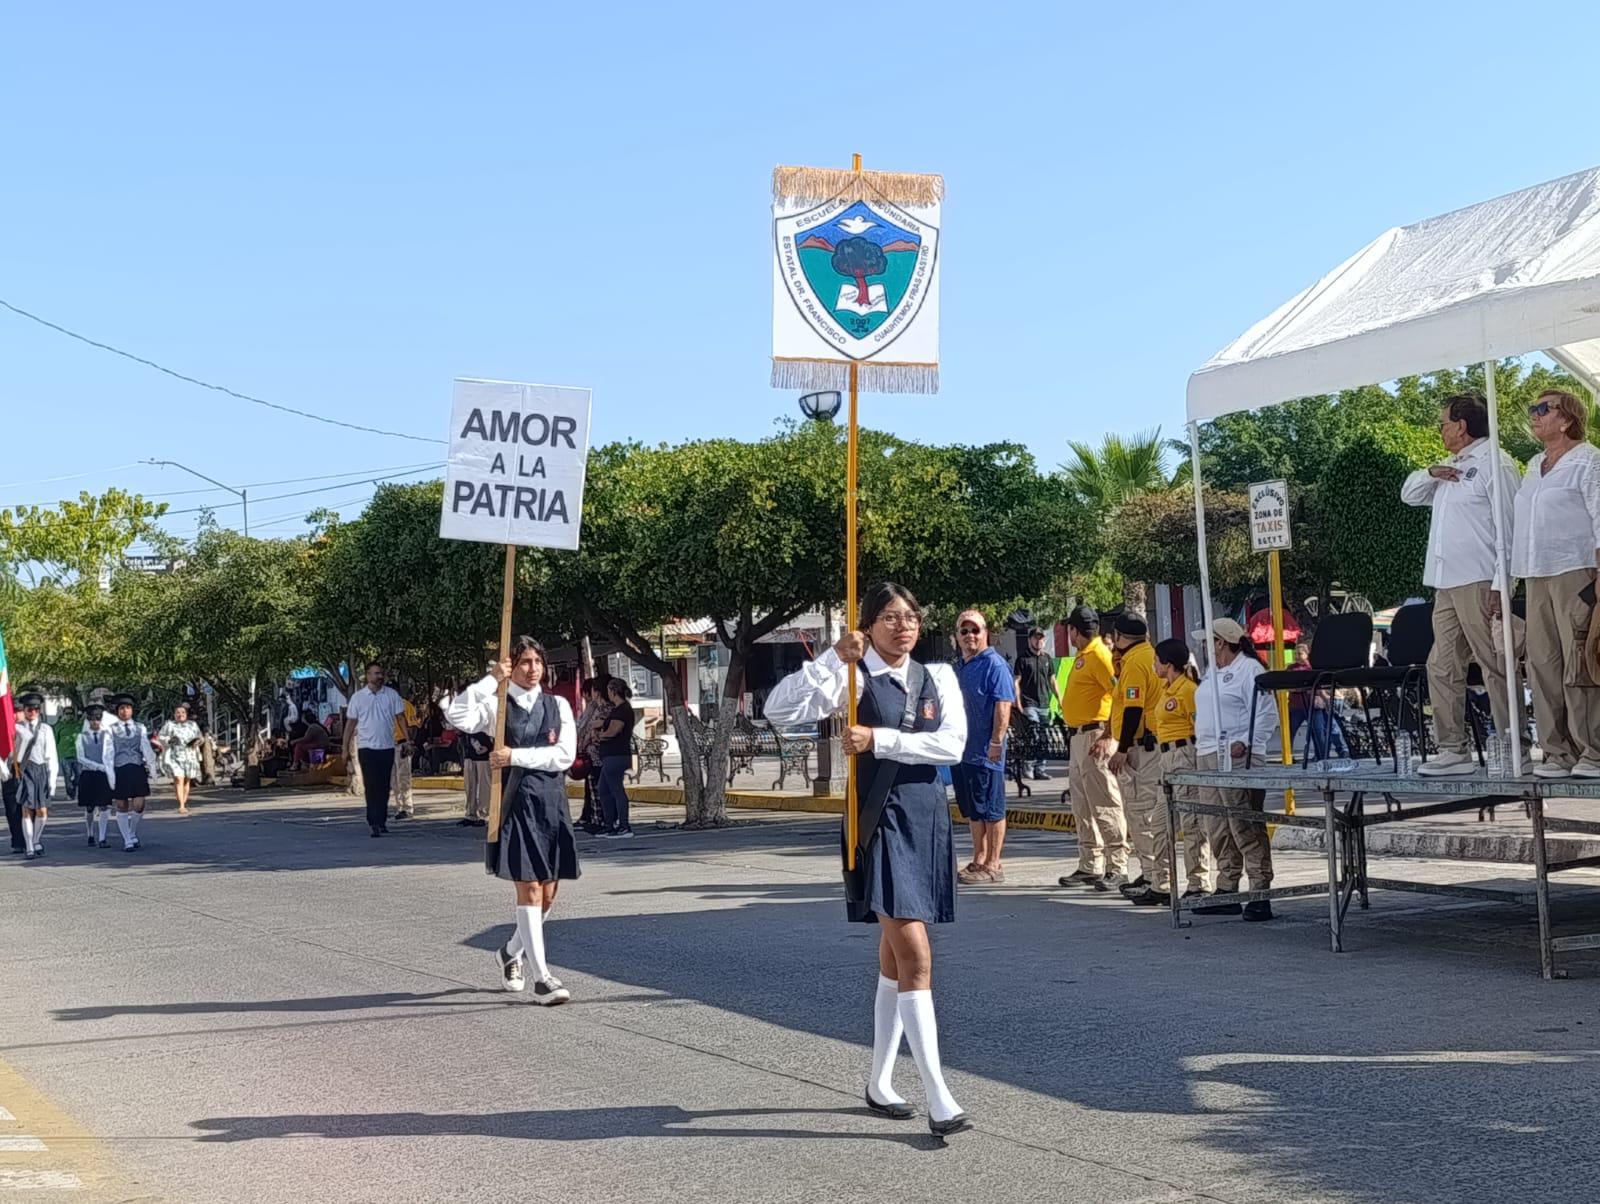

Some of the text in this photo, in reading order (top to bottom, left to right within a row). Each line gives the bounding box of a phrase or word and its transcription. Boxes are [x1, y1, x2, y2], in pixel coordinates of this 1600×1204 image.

[918, 245, 930, 280] CASTRO
[782, 236, 797, 280] ESTATAL
[803, 298, 847, 345] FRANCISCO
[460, 408, 577, 449] AMOR
[489, 452, 546, 479] A LA
[452, 480, 569, 524] PATRIA
[1255, 508, 1283, 519] ZONA DE
[1256, 520, 1283, 533] TAXIS
